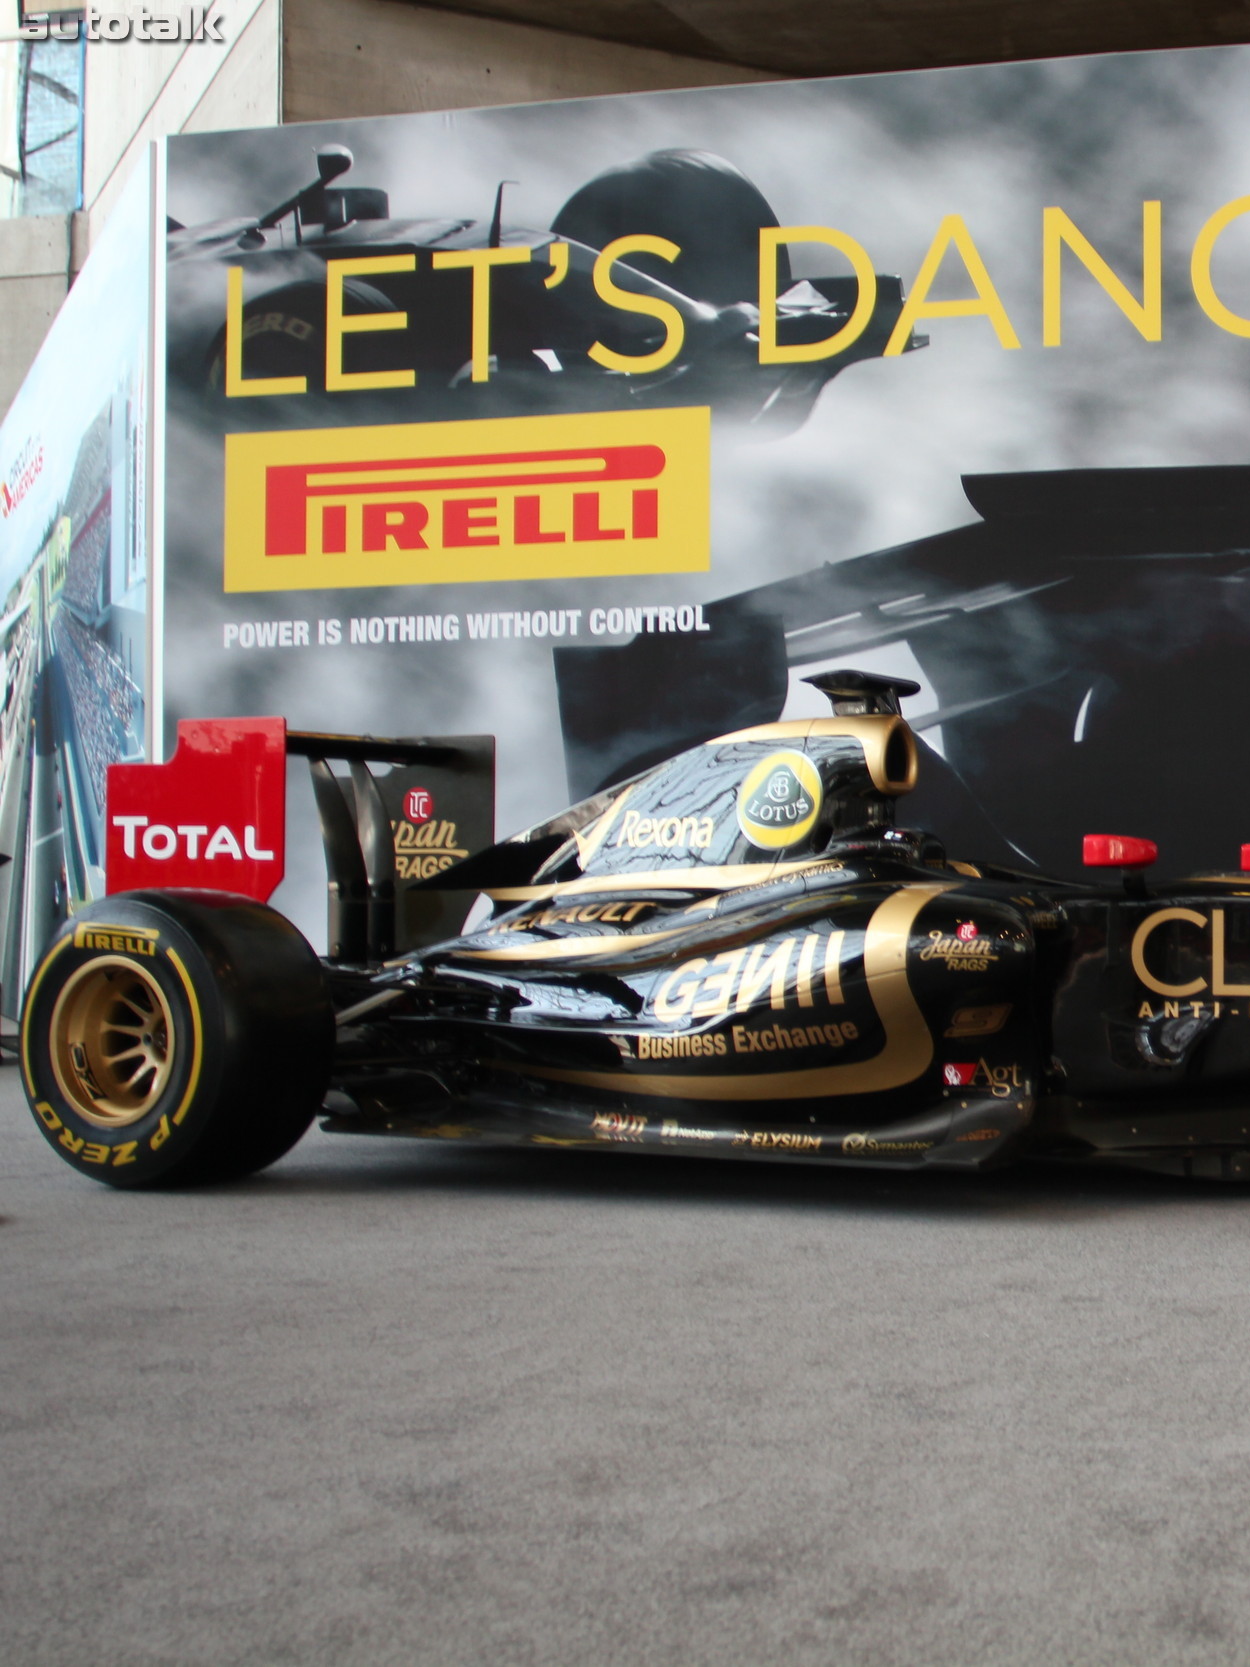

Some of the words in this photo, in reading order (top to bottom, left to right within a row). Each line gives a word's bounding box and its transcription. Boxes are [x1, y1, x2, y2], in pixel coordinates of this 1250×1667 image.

[225, 233, 686, 398] LET'S
[265, 444, 666, 556] PIRELLI
[223, 621, 309, 648] POWER
[318, 619, 342, 645] IS
[350, 614, 460, 643] NOTHING
[467, 609, 582, 638] WITHOUT
[589, 604, 710, 634] CONTROL
[616, 809, 714, 849] Rexona
[747, 797, 809, 822] LOTUS
[112, 815, 274, 860] TOTAL
[486, 901, 656, 936] RENAULT
[72, 922, 160, 956] PIRELLI
[920, 930, 992, 962] Japan
[949, 958, 988, 971] RAGS
[638, 1033, 728, 1059] Business
[732, 1021, 860, 1053] Exchange
[968, 1056, 1022, 1097] Agt
[35, 1102, 138, 1167] ZERO
[751, 1132, 822, 1150] ELYSIUM
